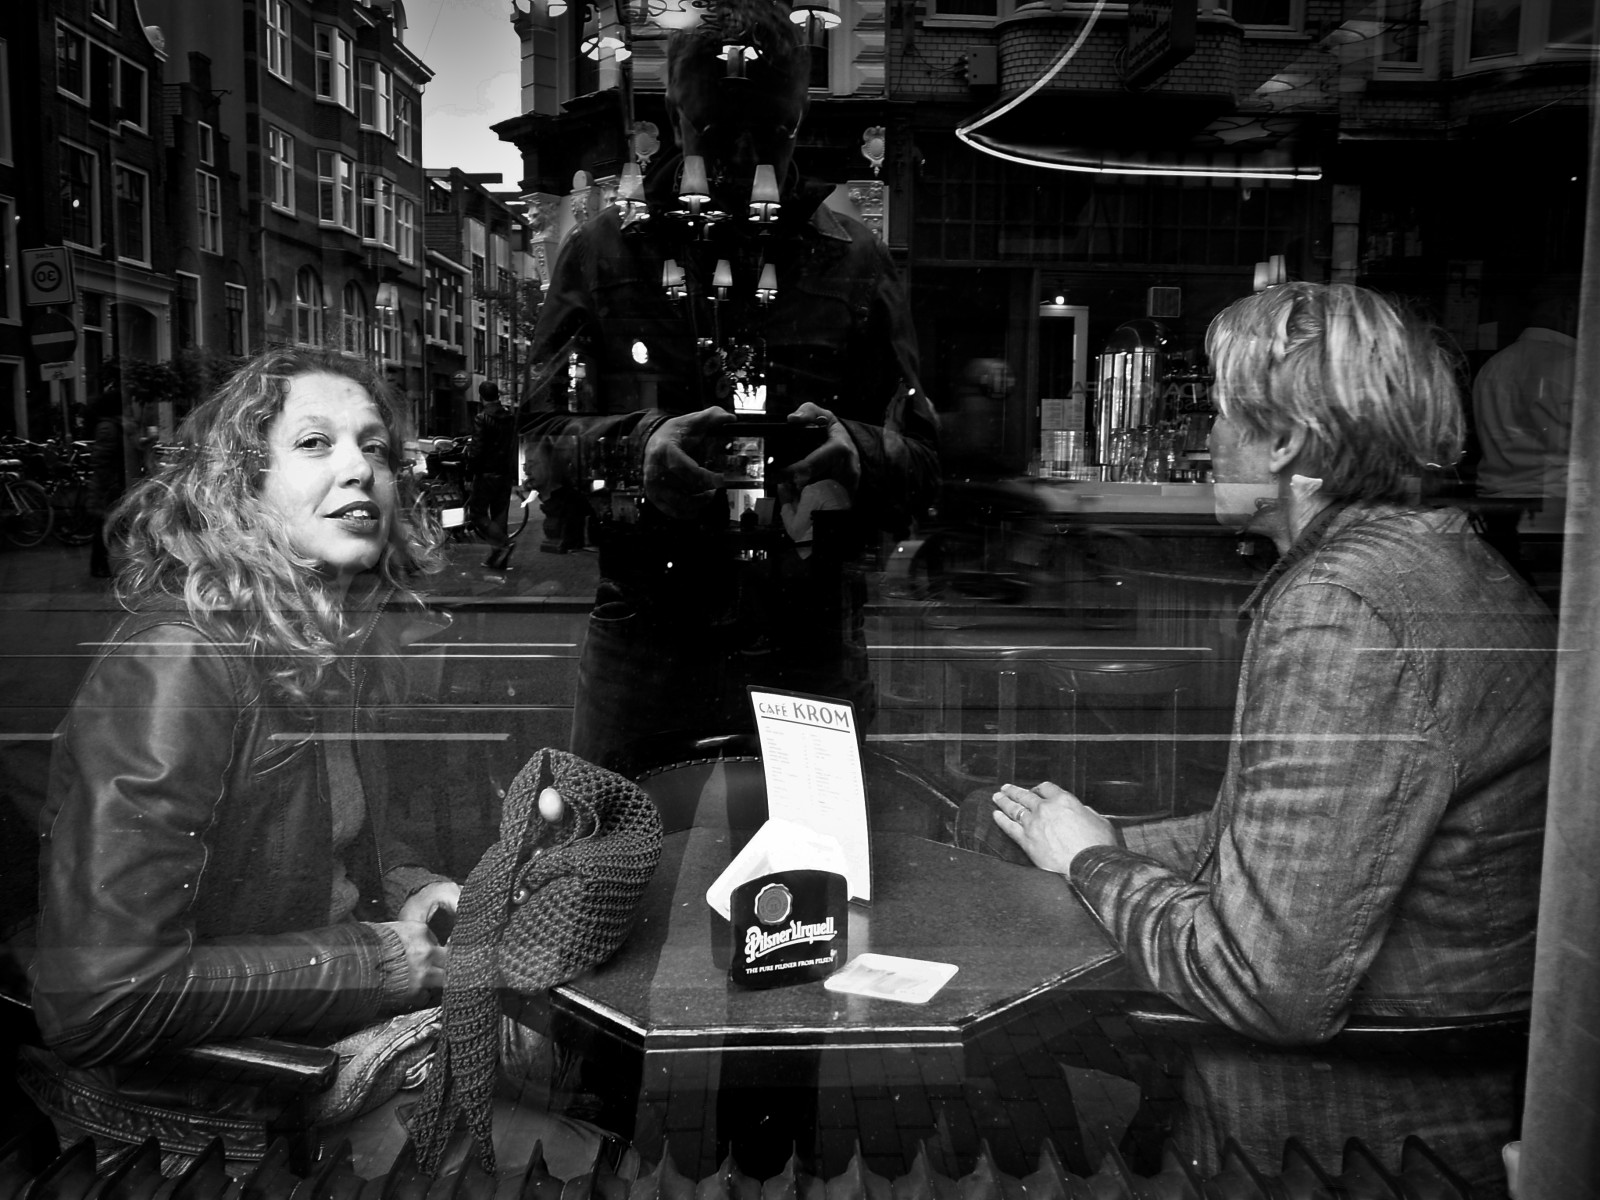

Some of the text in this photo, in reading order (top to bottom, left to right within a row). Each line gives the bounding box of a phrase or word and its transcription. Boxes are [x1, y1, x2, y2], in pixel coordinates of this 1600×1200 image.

[759, 702, 850, 728] CAFÉ KROM
[744, 925, 791, 963] Pilsner
[745, 957, 834, 975] THE PURE PILSNER FROM PILSEN
